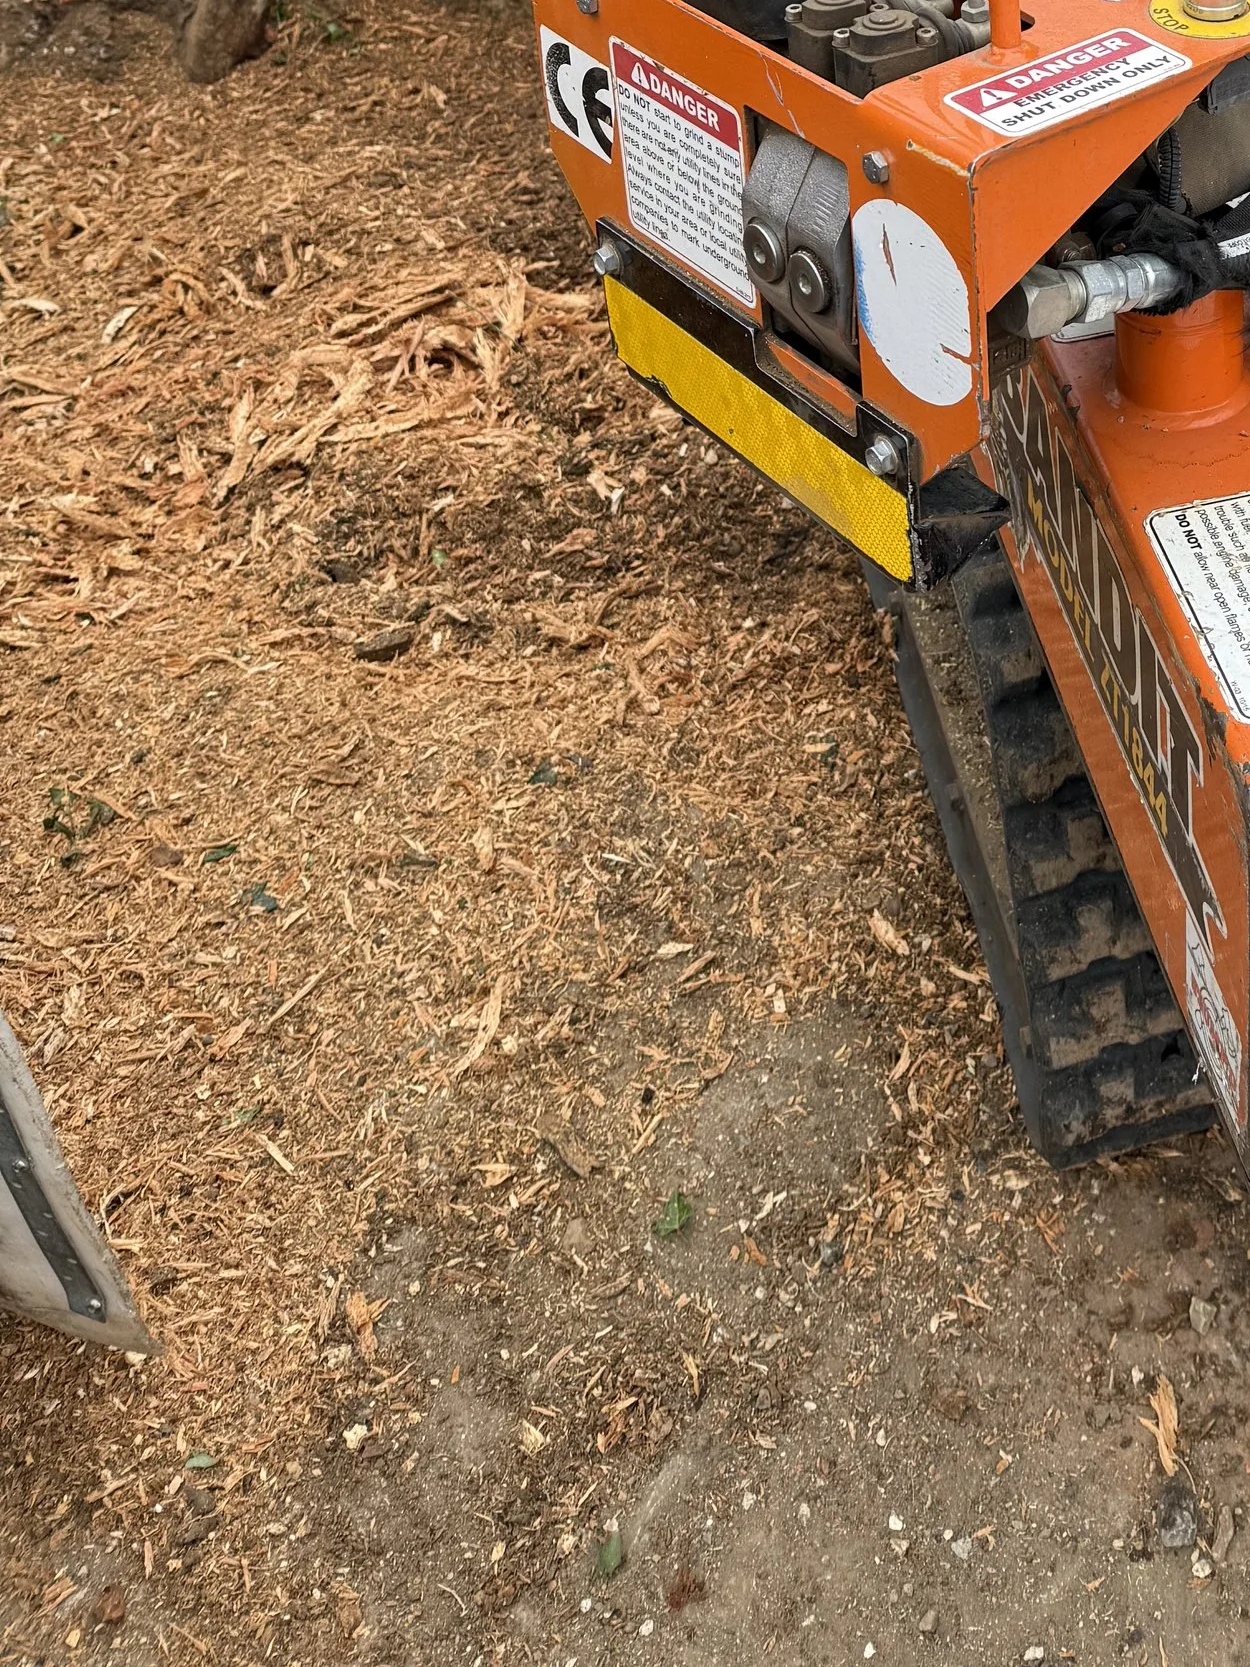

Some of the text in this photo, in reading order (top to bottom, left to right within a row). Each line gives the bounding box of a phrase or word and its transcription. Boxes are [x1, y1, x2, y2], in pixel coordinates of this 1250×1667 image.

[1152, 7, 1191, 32] STOP
[1002, 55, 1170, 126] SHUT DOWN ONLY
[1007, 38, 1129, 87] DANGER
[1013, 58, 1129, 106] EMERGENCY
[618, 84, 739, 167] DO NOT start to grind a stump
[650, 74, 718, 130] DANGER
[646, 162, 670, 184] where
[674, 181, 688, 196] you
[692, 192, 705, 206] are
[709, 200, 742, 233] grinding
[1174, 513, 1190, 527] DO
[1182, 529, 1201, 549] NOT
[1193, 551, 1209, 570] allow
[1203, 572, 1220, 590] near
[1213, 591, 1230, 613] open
[1224, 613, 1245, 642] flames
[1025, 477, 1169, 837] MODEL ZT1844
